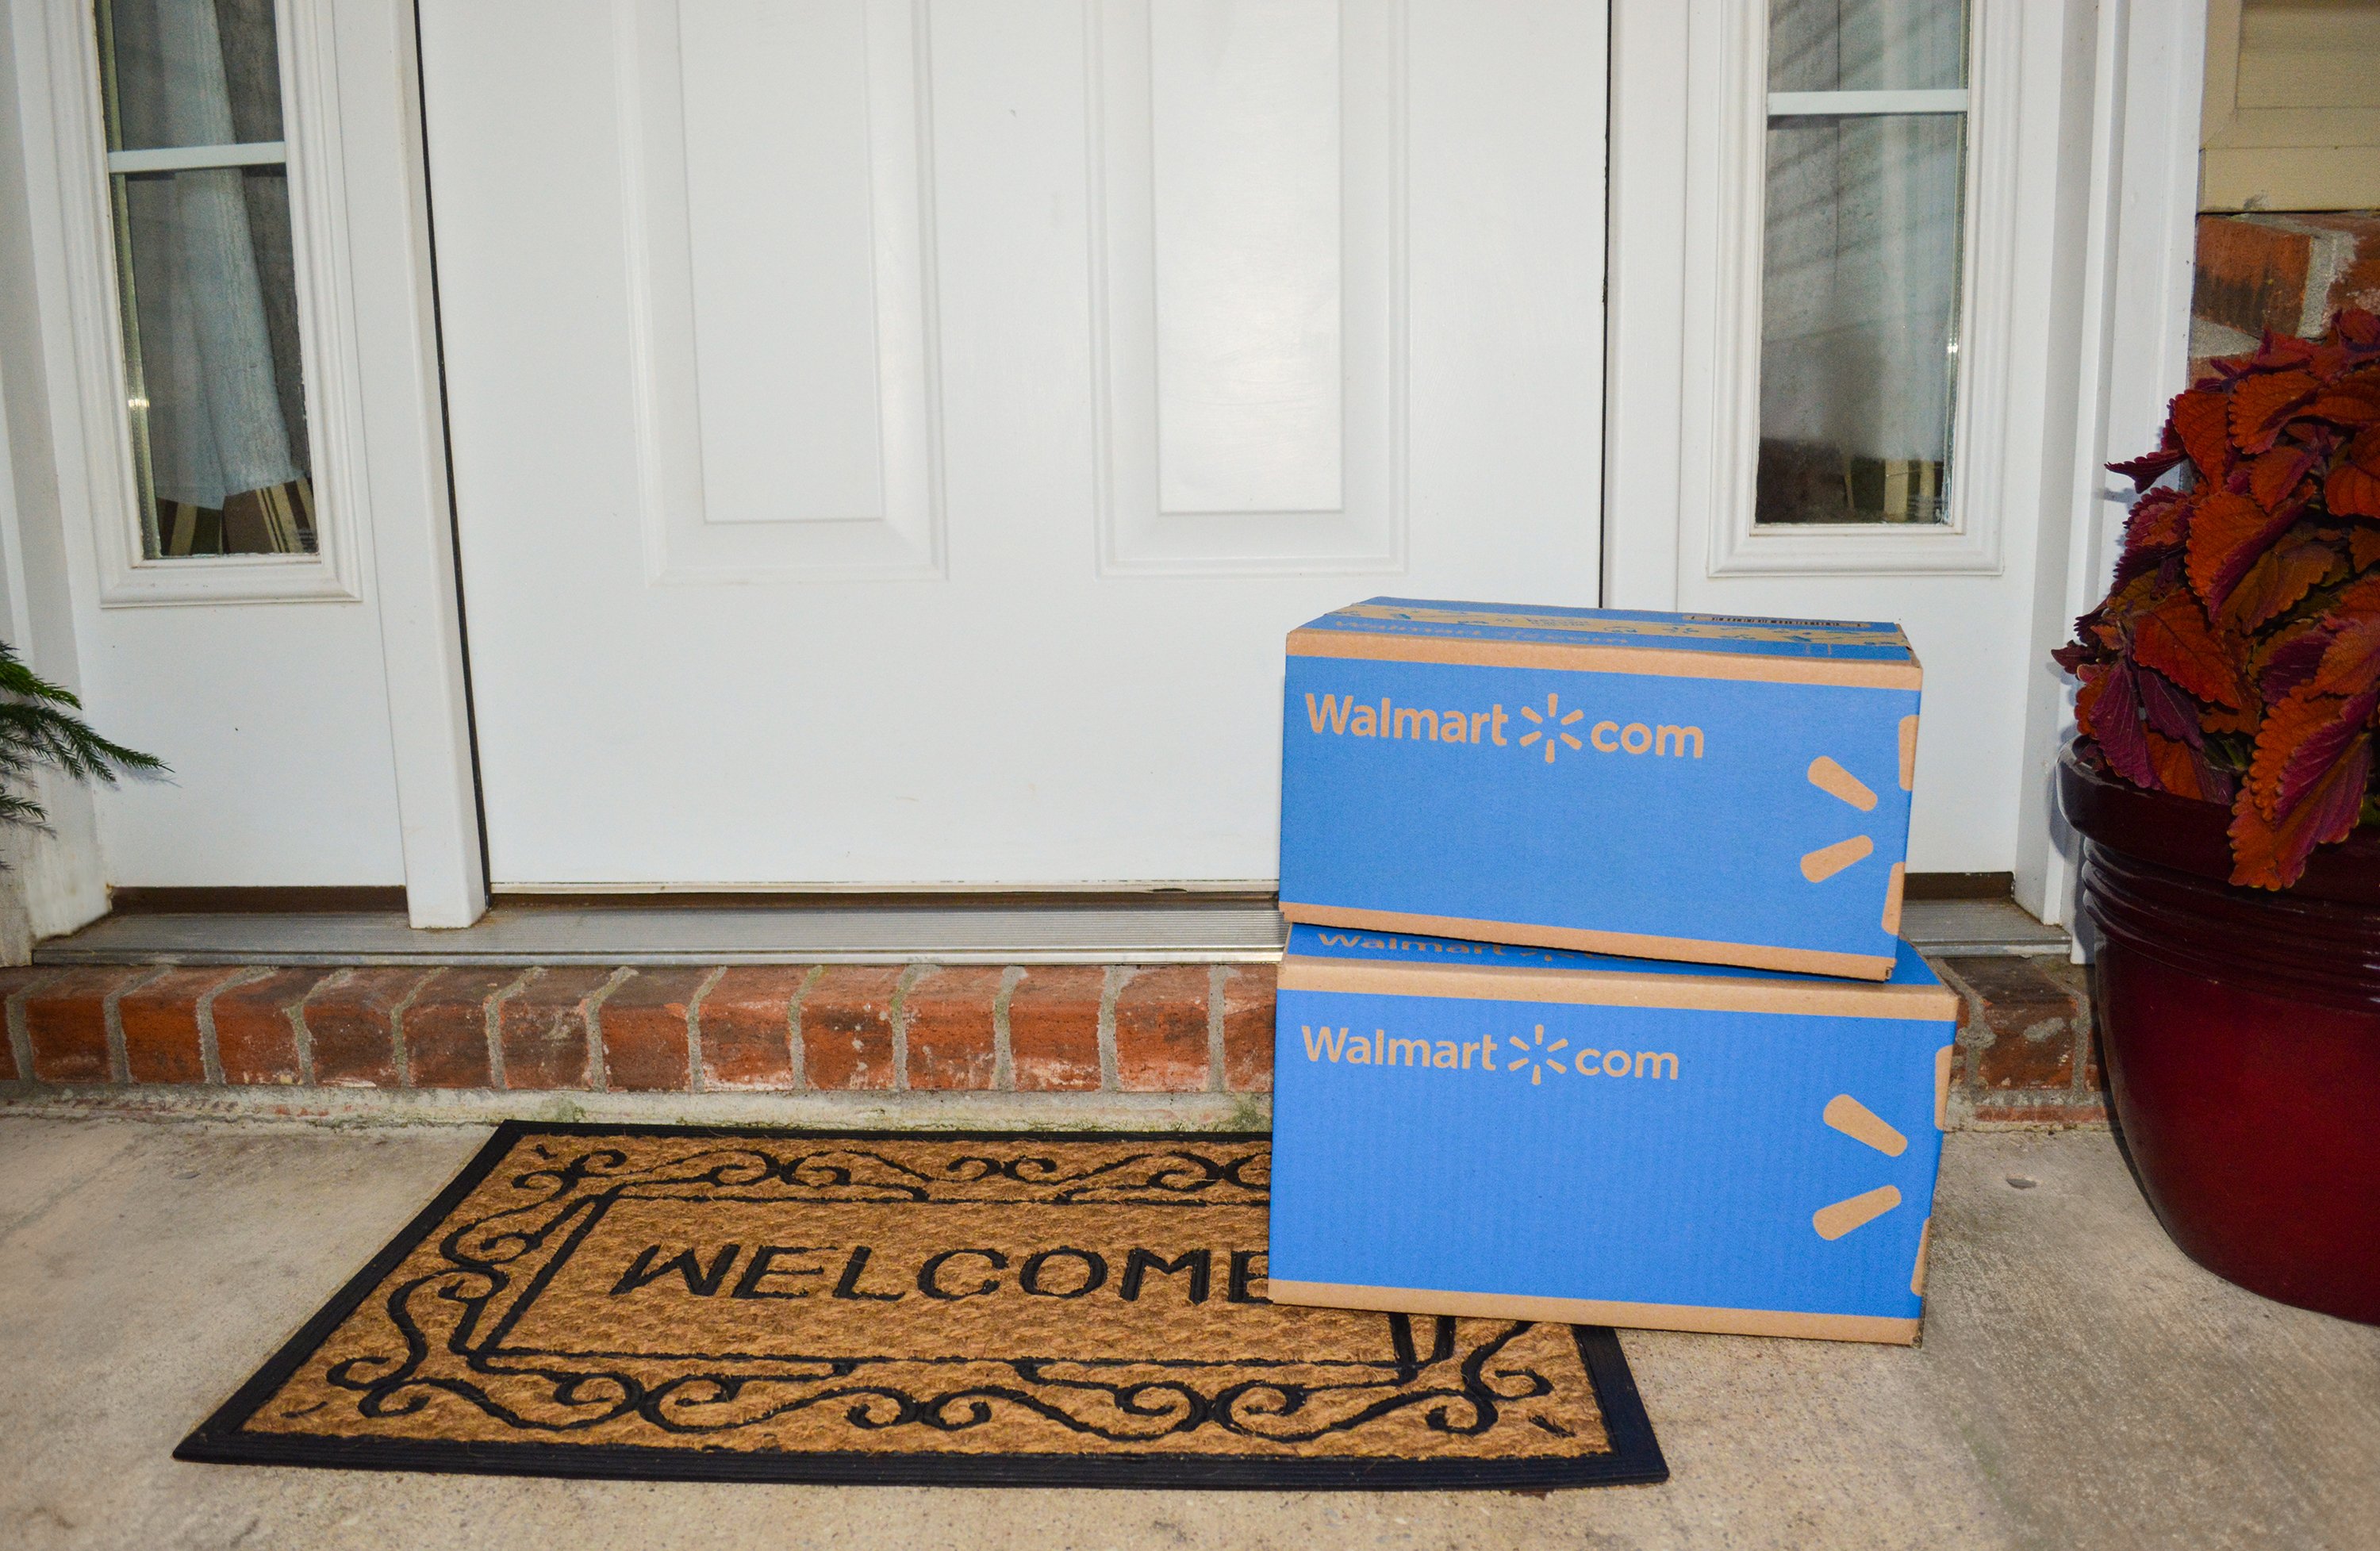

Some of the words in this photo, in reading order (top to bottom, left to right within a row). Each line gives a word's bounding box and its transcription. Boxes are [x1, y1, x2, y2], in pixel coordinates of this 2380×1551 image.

[1305, 693, 1508, 747] Walmart
[1591, 720, 1705, 758] com
[1301, 1025, 1499, 1071] Walmart
[1575, 1048, 1679, 1080] com
[609, 1243, 1273, 1305] WELCOME
